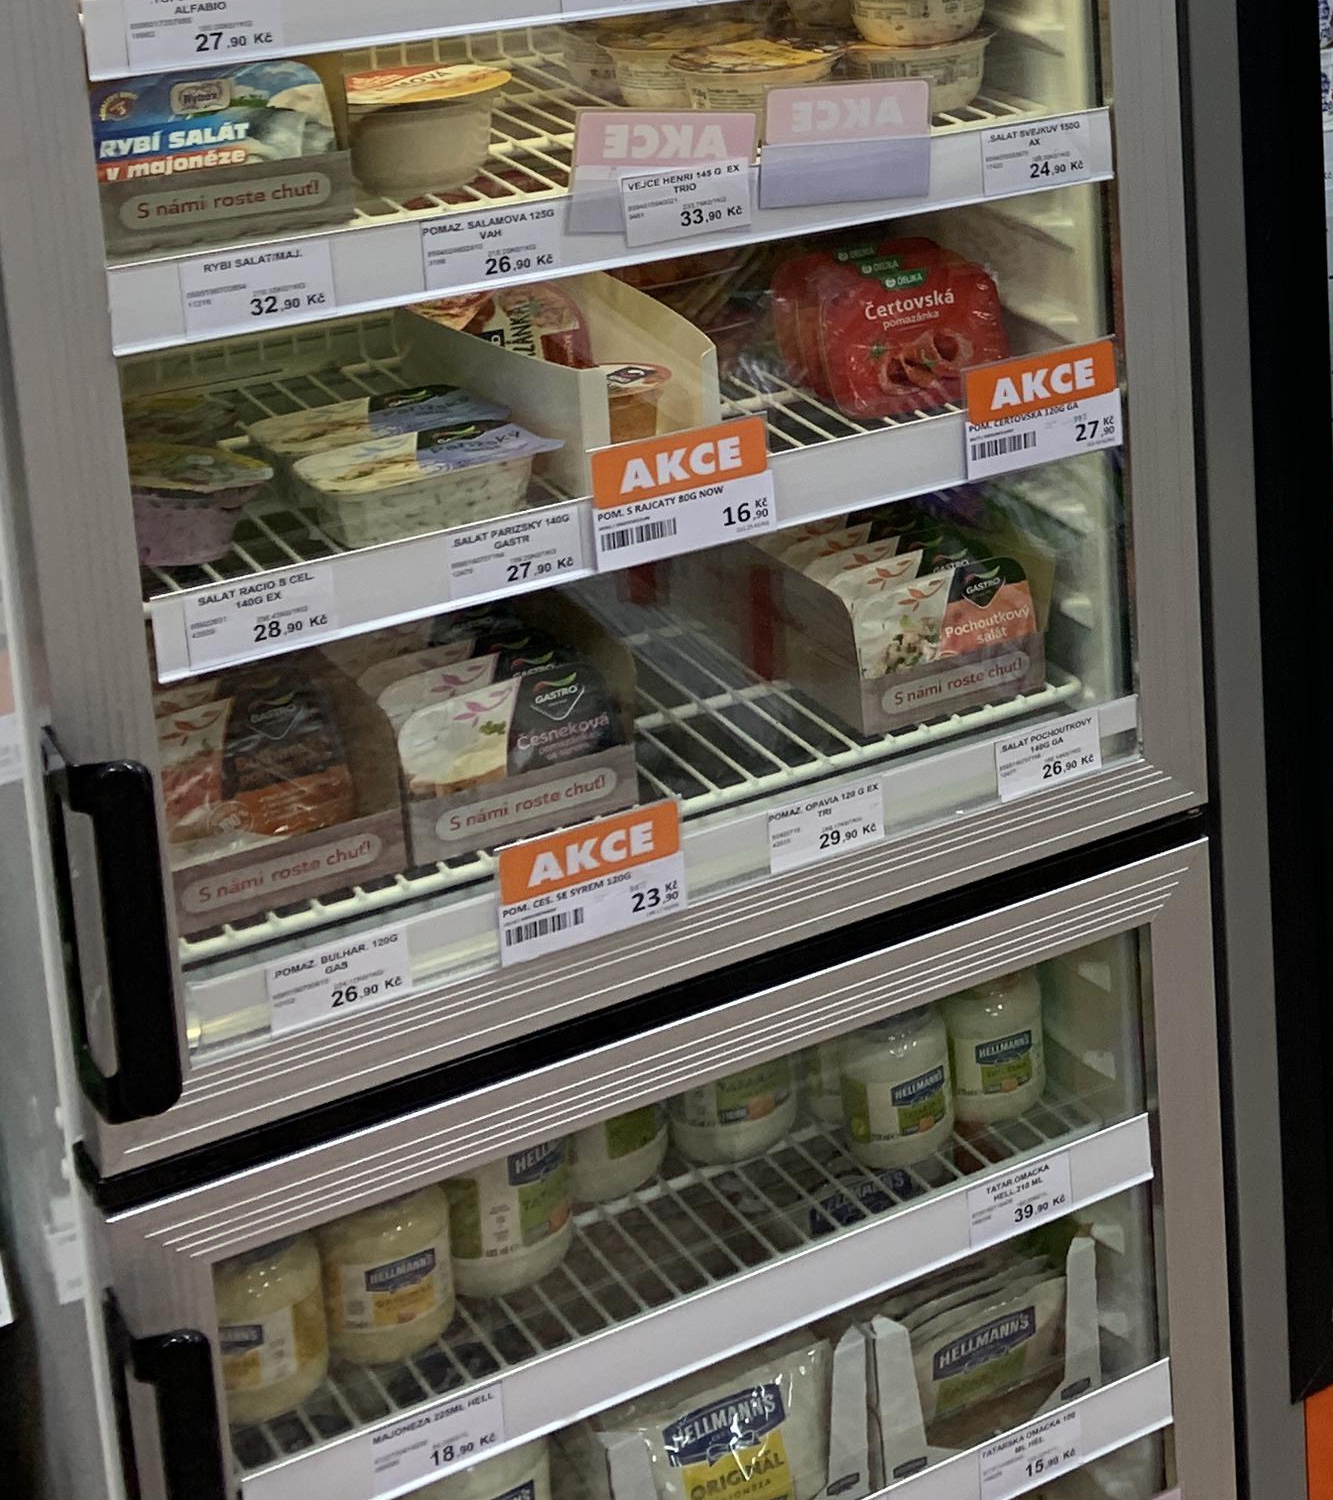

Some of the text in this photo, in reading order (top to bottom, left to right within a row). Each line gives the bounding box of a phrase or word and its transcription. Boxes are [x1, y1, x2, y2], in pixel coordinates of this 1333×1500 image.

[175, 2, 227, 14] ALFABIO
[99, 121, 249, 160] RYBÍ SALÁT
[1029, 138, 1040, 146] AX
[106, 149, 246, 180] v majonéze
[1071, 160, 1084, 171] Kč
[628, 178, 660, 191] VEJCE
[663, 173, 694, 185] HENRI
[696, 169, 712, 179] 145
[727, 164, 740, 173] EX
[674, 183, 697, 194] TRIO
[137, 202, 149, 219] S
[156, 197, 208, 215] námi
[214, 190, 266, 209] roste
[727, 205, 743, 217] Kč
[468, 214, 528, 231] SALAMOVA
[530, 209, 554, 221] 125G
[479, 229, 502, 240] VAH
[203, 261, 232, 273] RYBI
[537, 254, 554, 266] Kč
[865, 289, 955, 321] Čertovská
[883, 309, 939, 331] pomazánka
[991, 357, 1095, 411] AKCE
[1076, 420, 1099, 442] 27
[1103, 416, 1114, 426] Kč
[620, 436, 743, 495] AKCE
[598, 508, 624, 521] POM.
[627, 506, 633, 515] S
[635, 496, 676, 513] RAJCATY
[699, 485, 724, 499] NOW
[755, 498, 768, 508] Kč
[723, 503, 751, 527] 16
[494, 535, 530, 550] GASTR
[198, 590, 236, 607] SALAT
[239, 580, 275, 596] RACIO
[266, 591, 282, 602] EX
[966, 577, 1000, 595] GASTRO
[944, 605, 1031, 639] Pochoutkový
[976, 626, 1008, 645] salát
[534, 684, 579, 705] GASTRO
[894, 691, 905, 705] S
[906, 682, 943, 702] námi
[947, 671, 985, 691] roste
[516, 712, 611, 751] Česneková
[1030, 716, 1092, 744] POCHOUTKOVY
[449, 815, 463, 832] S
[466, 805, 509, 828] námi
[513, 789, 562, 813] roste
[817, 807, 832, 818] TRI
[527, 821, 654, 889] AKCE
[198, 887, 213, 902] S
[216, 874, 265, 897] námi
[270, 859, 322, 882] roste
[665, 881, 677, 891] Kč
[503, 904, 530, 918] POM.
[556, 891, 568, 901] SE
[570, 881, 604, 897] SYREM
[632, 888, 661, 914] 23
